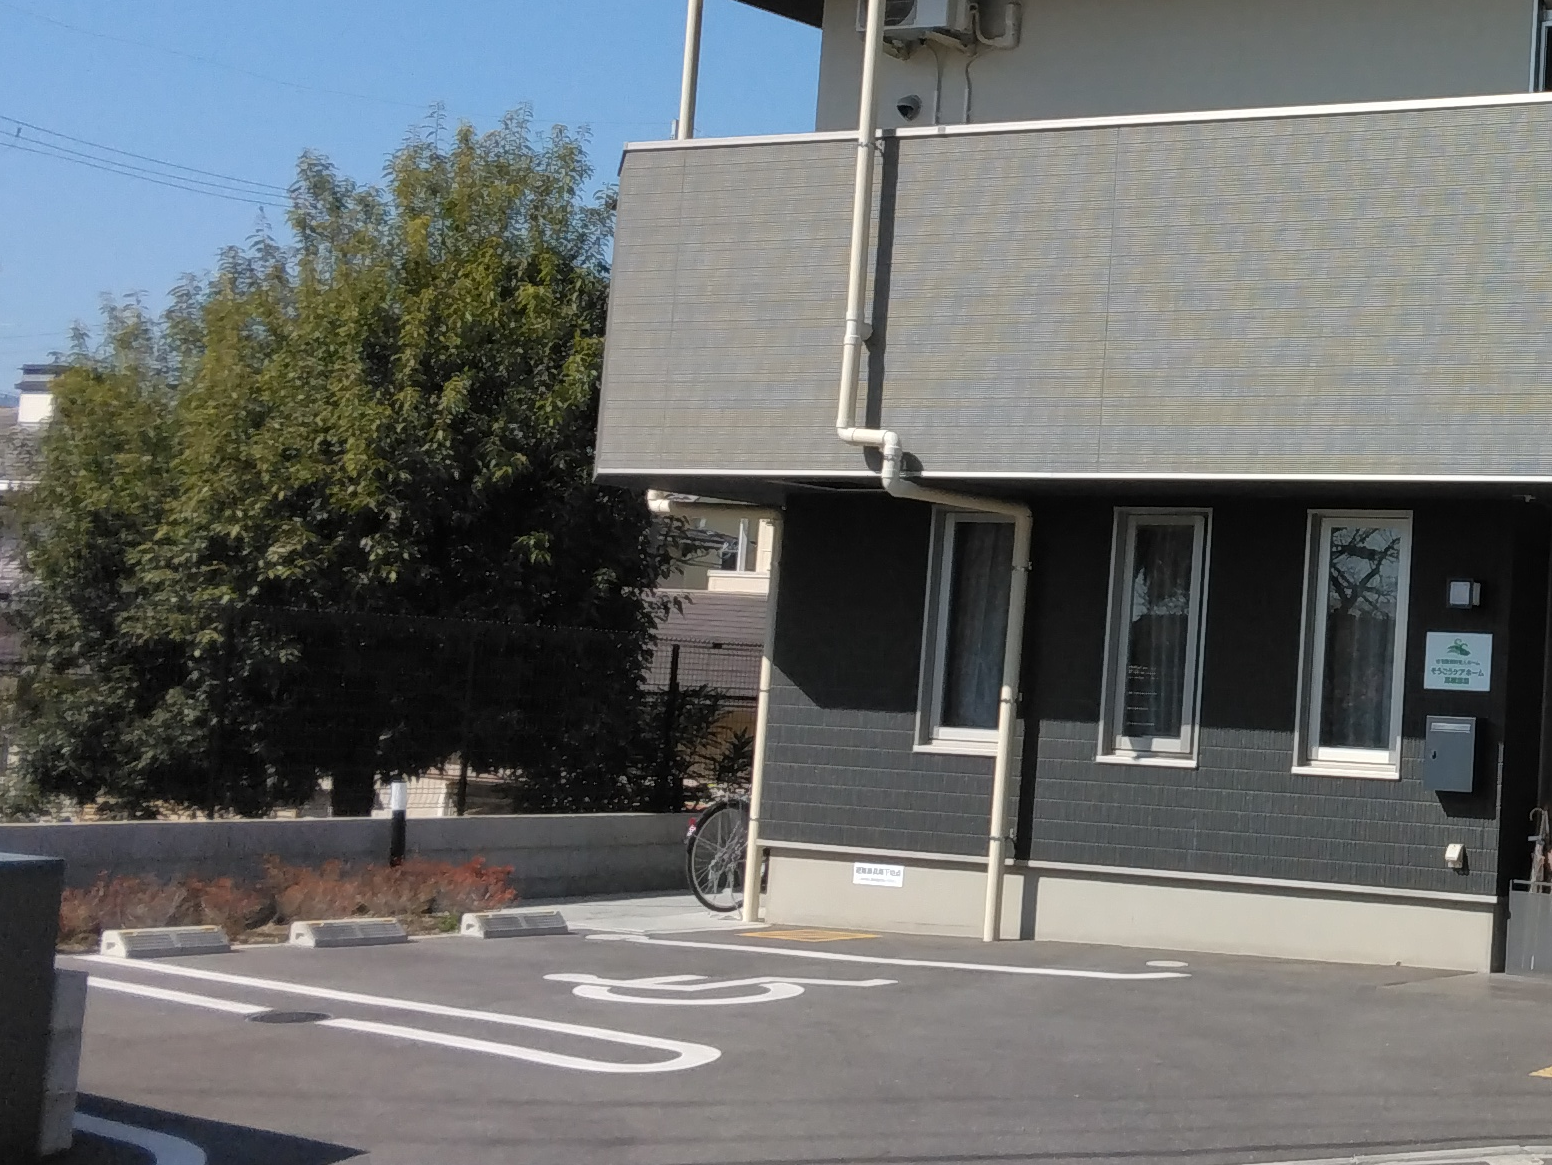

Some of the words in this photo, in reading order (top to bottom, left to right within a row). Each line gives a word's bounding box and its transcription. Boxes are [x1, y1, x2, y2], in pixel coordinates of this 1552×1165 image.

[1430, 667, 1485, 677] そうこうケアホーム
